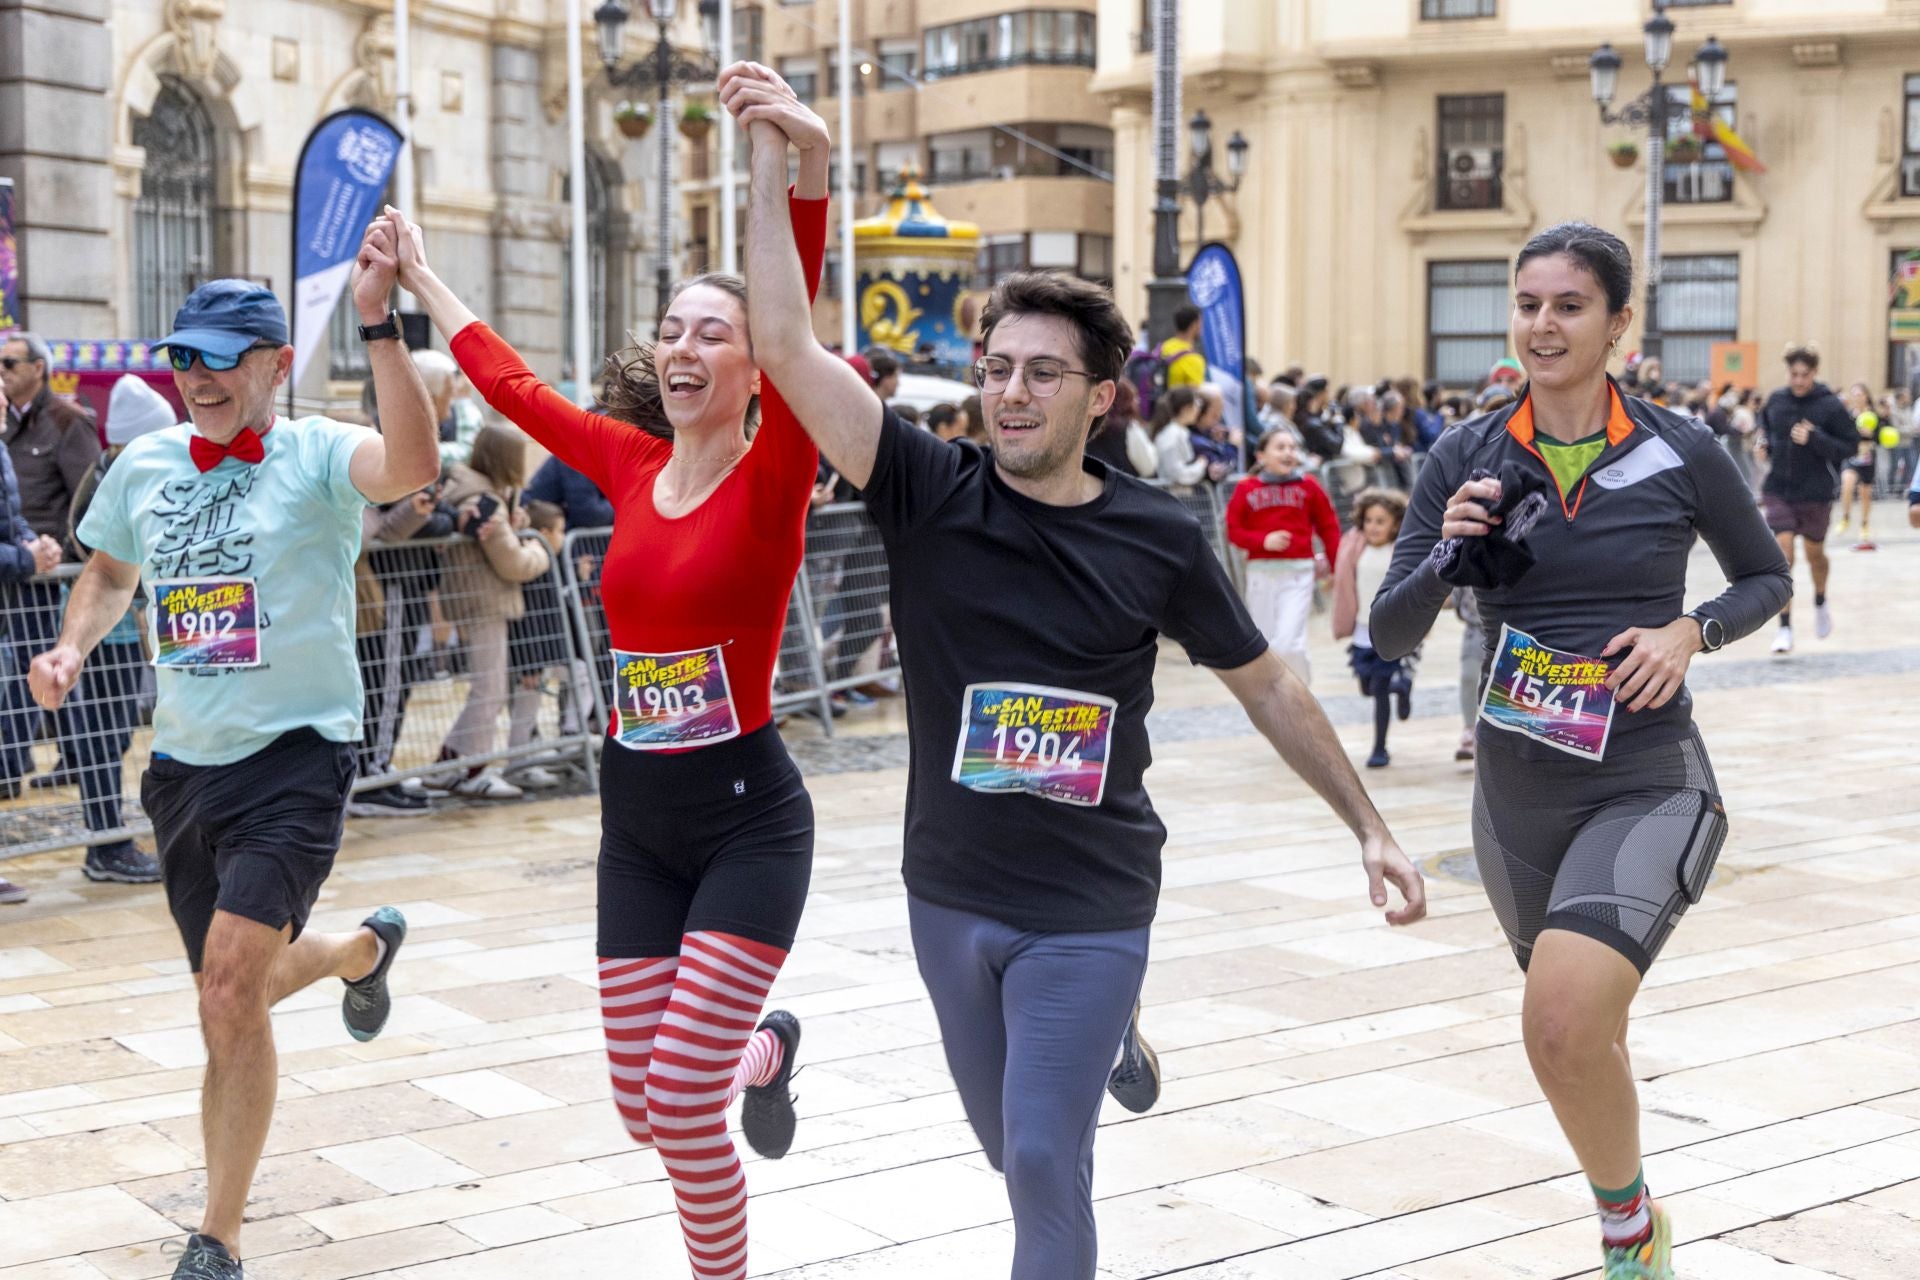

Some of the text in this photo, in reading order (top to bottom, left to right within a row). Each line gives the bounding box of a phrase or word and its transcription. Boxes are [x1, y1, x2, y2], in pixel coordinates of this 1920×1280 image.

[168, 584, 245, 614] SILVESTRE
[169, 585, 197, 601] SAN
[168, 610, 237, 641] 1902
[1523, 646, 1553, 665] SAN
[627, 658, 657, 676] SAN
[629, 653, 708, 688] SILVESTRE
[1519, 659, 1609, 677] SILVESTRE
[1548, 677, 1605, 686] CARTAGENA
[628, 684, 708, 717] 1903
[1000, 696, 1043, 713] SAN
[1510, 670, 1586, 720] 1541
[997, 706, 1101, 729] SILVESTRE
[1042, 720, 1098, 733] CARTAGENA
[993, 725, 1082, 771] 1904
